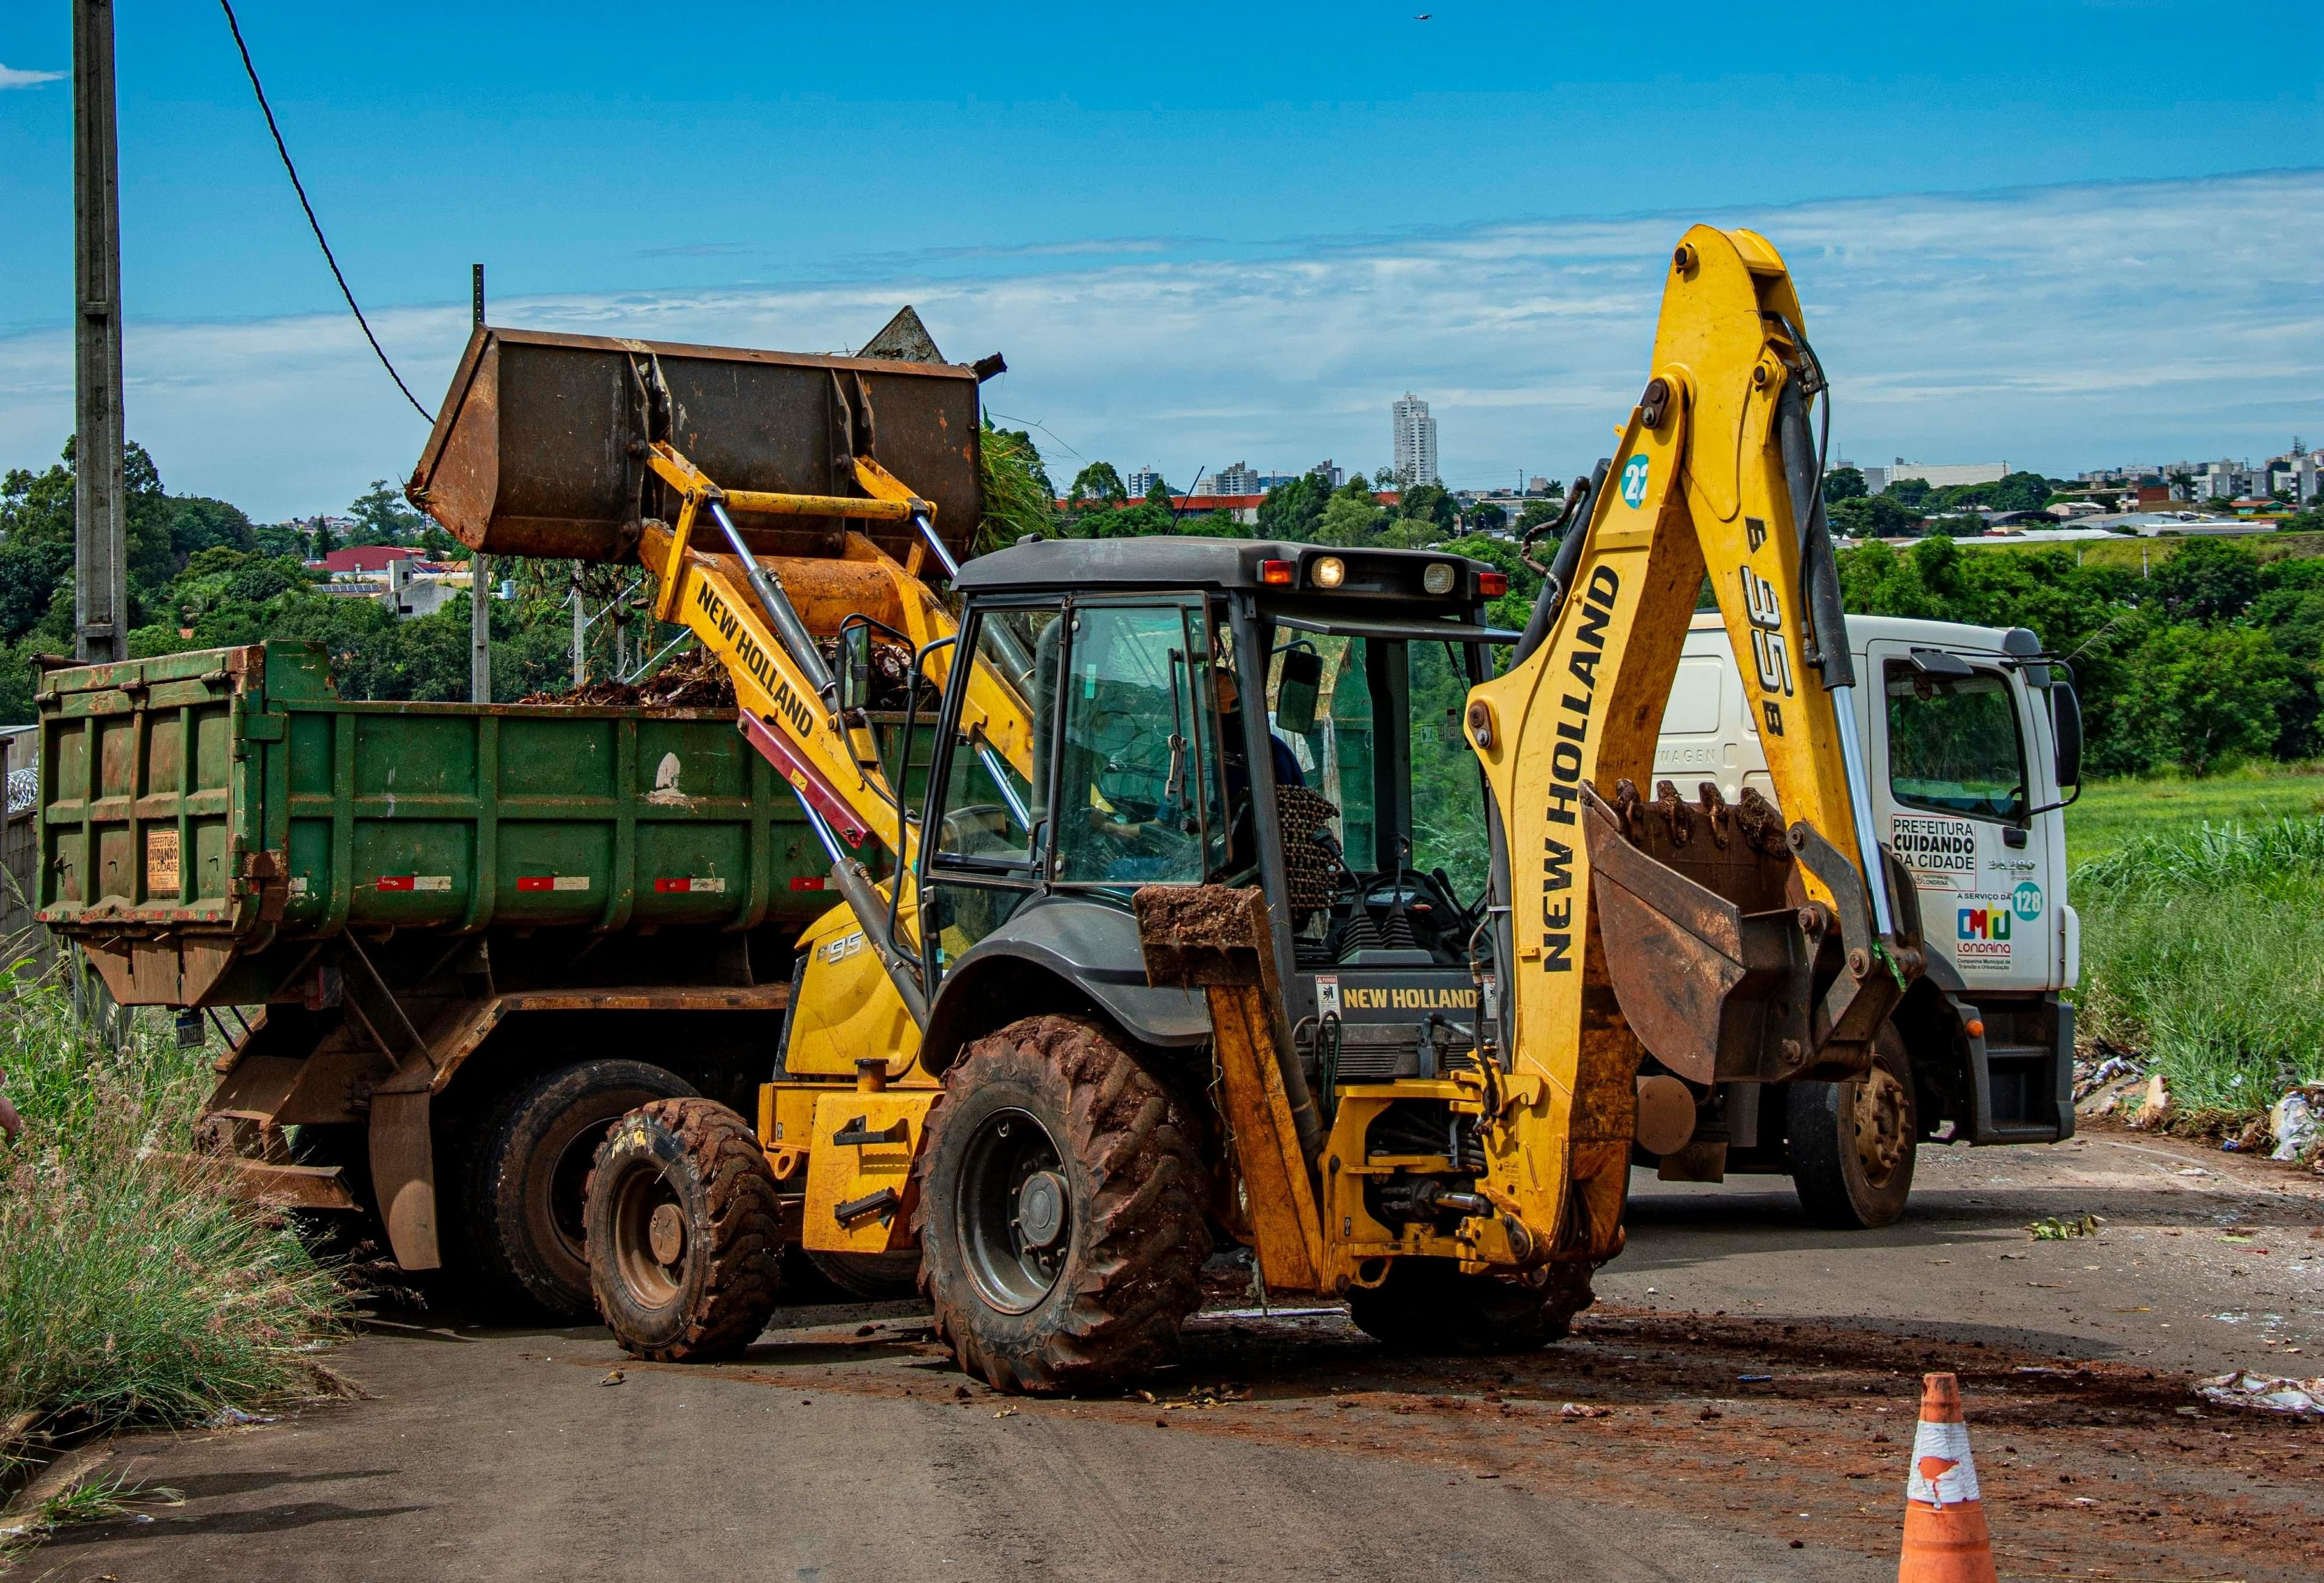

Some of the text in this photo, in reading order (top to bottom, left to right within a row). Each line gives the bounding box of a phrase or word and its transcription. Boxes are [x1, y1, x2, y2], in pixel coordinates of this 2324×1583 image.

[697, 581, 813, 738] NEW HOLLAND
[1543, 565, 1620, 972] NEW HOLLAND
[1893, 819, 1974, 836] PREFEITURA
[149, 836, 177, 847] PREFEITURA
[1894, 834, 1974, 854] CUIDANDO
[149, 847, 178, 861] CUIDANDO
[1918, 854, 1974, 870] CIDADE
[148, 862, 177, 872] DA CIDADE
[2015, 891, 2041, 912] 128
[1343, 989, 1387, 1008] NEW
[1391, 989, 1477, 1008] HOLLAND
